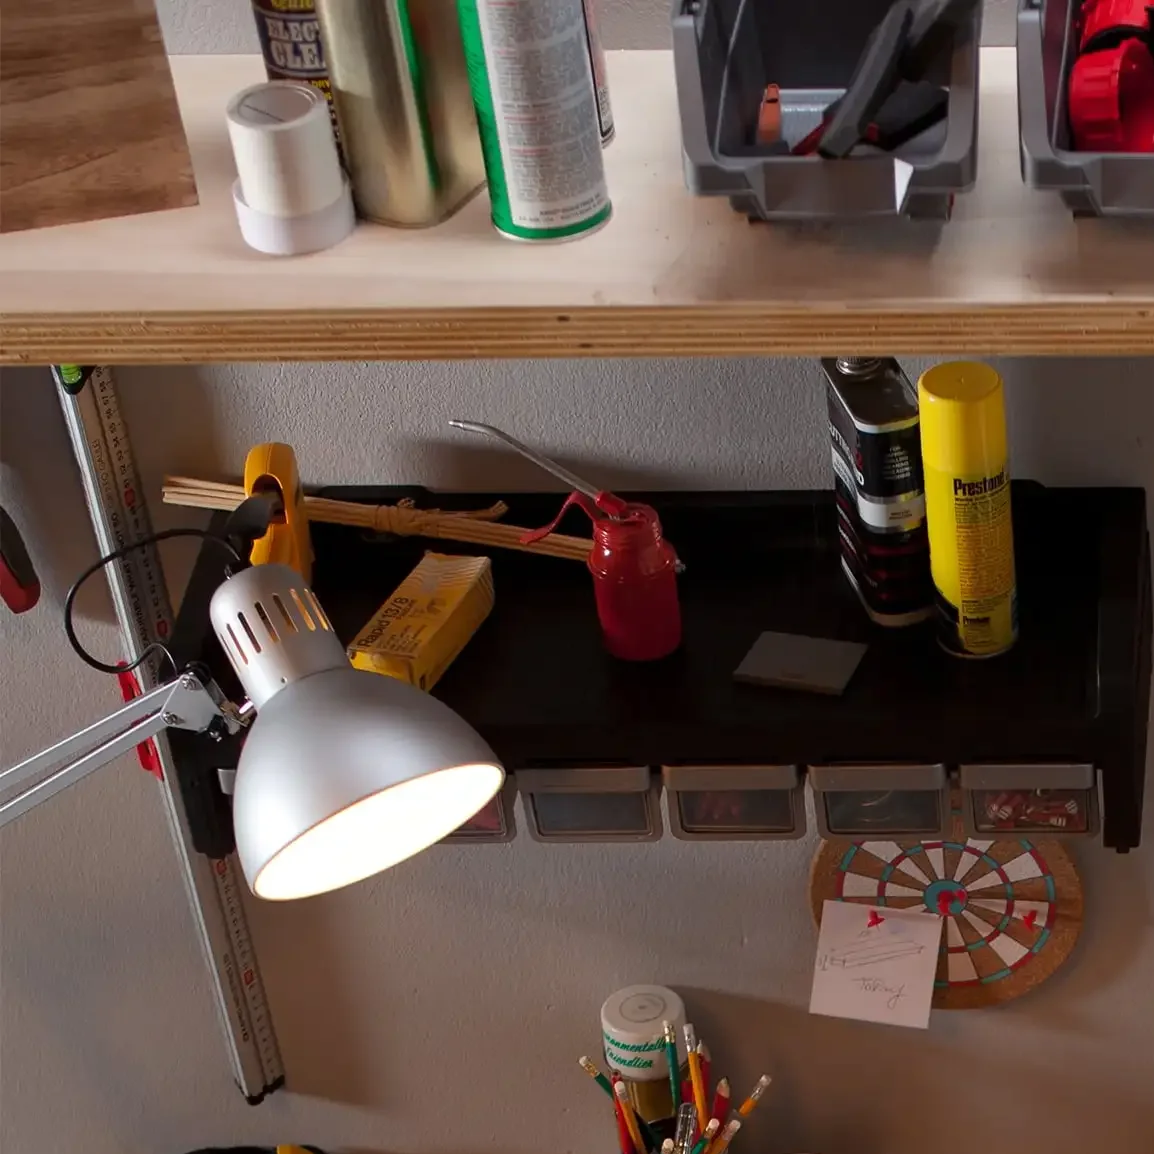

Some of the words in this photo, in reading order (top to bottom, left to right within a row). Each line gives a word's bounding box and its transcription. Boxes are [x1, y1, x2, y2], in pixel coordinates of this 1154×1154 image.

[269, 41, 327, 68] CLE
[953, 471, 1004, 497] Prestone
[357, 619, 390, 648] Rapid
